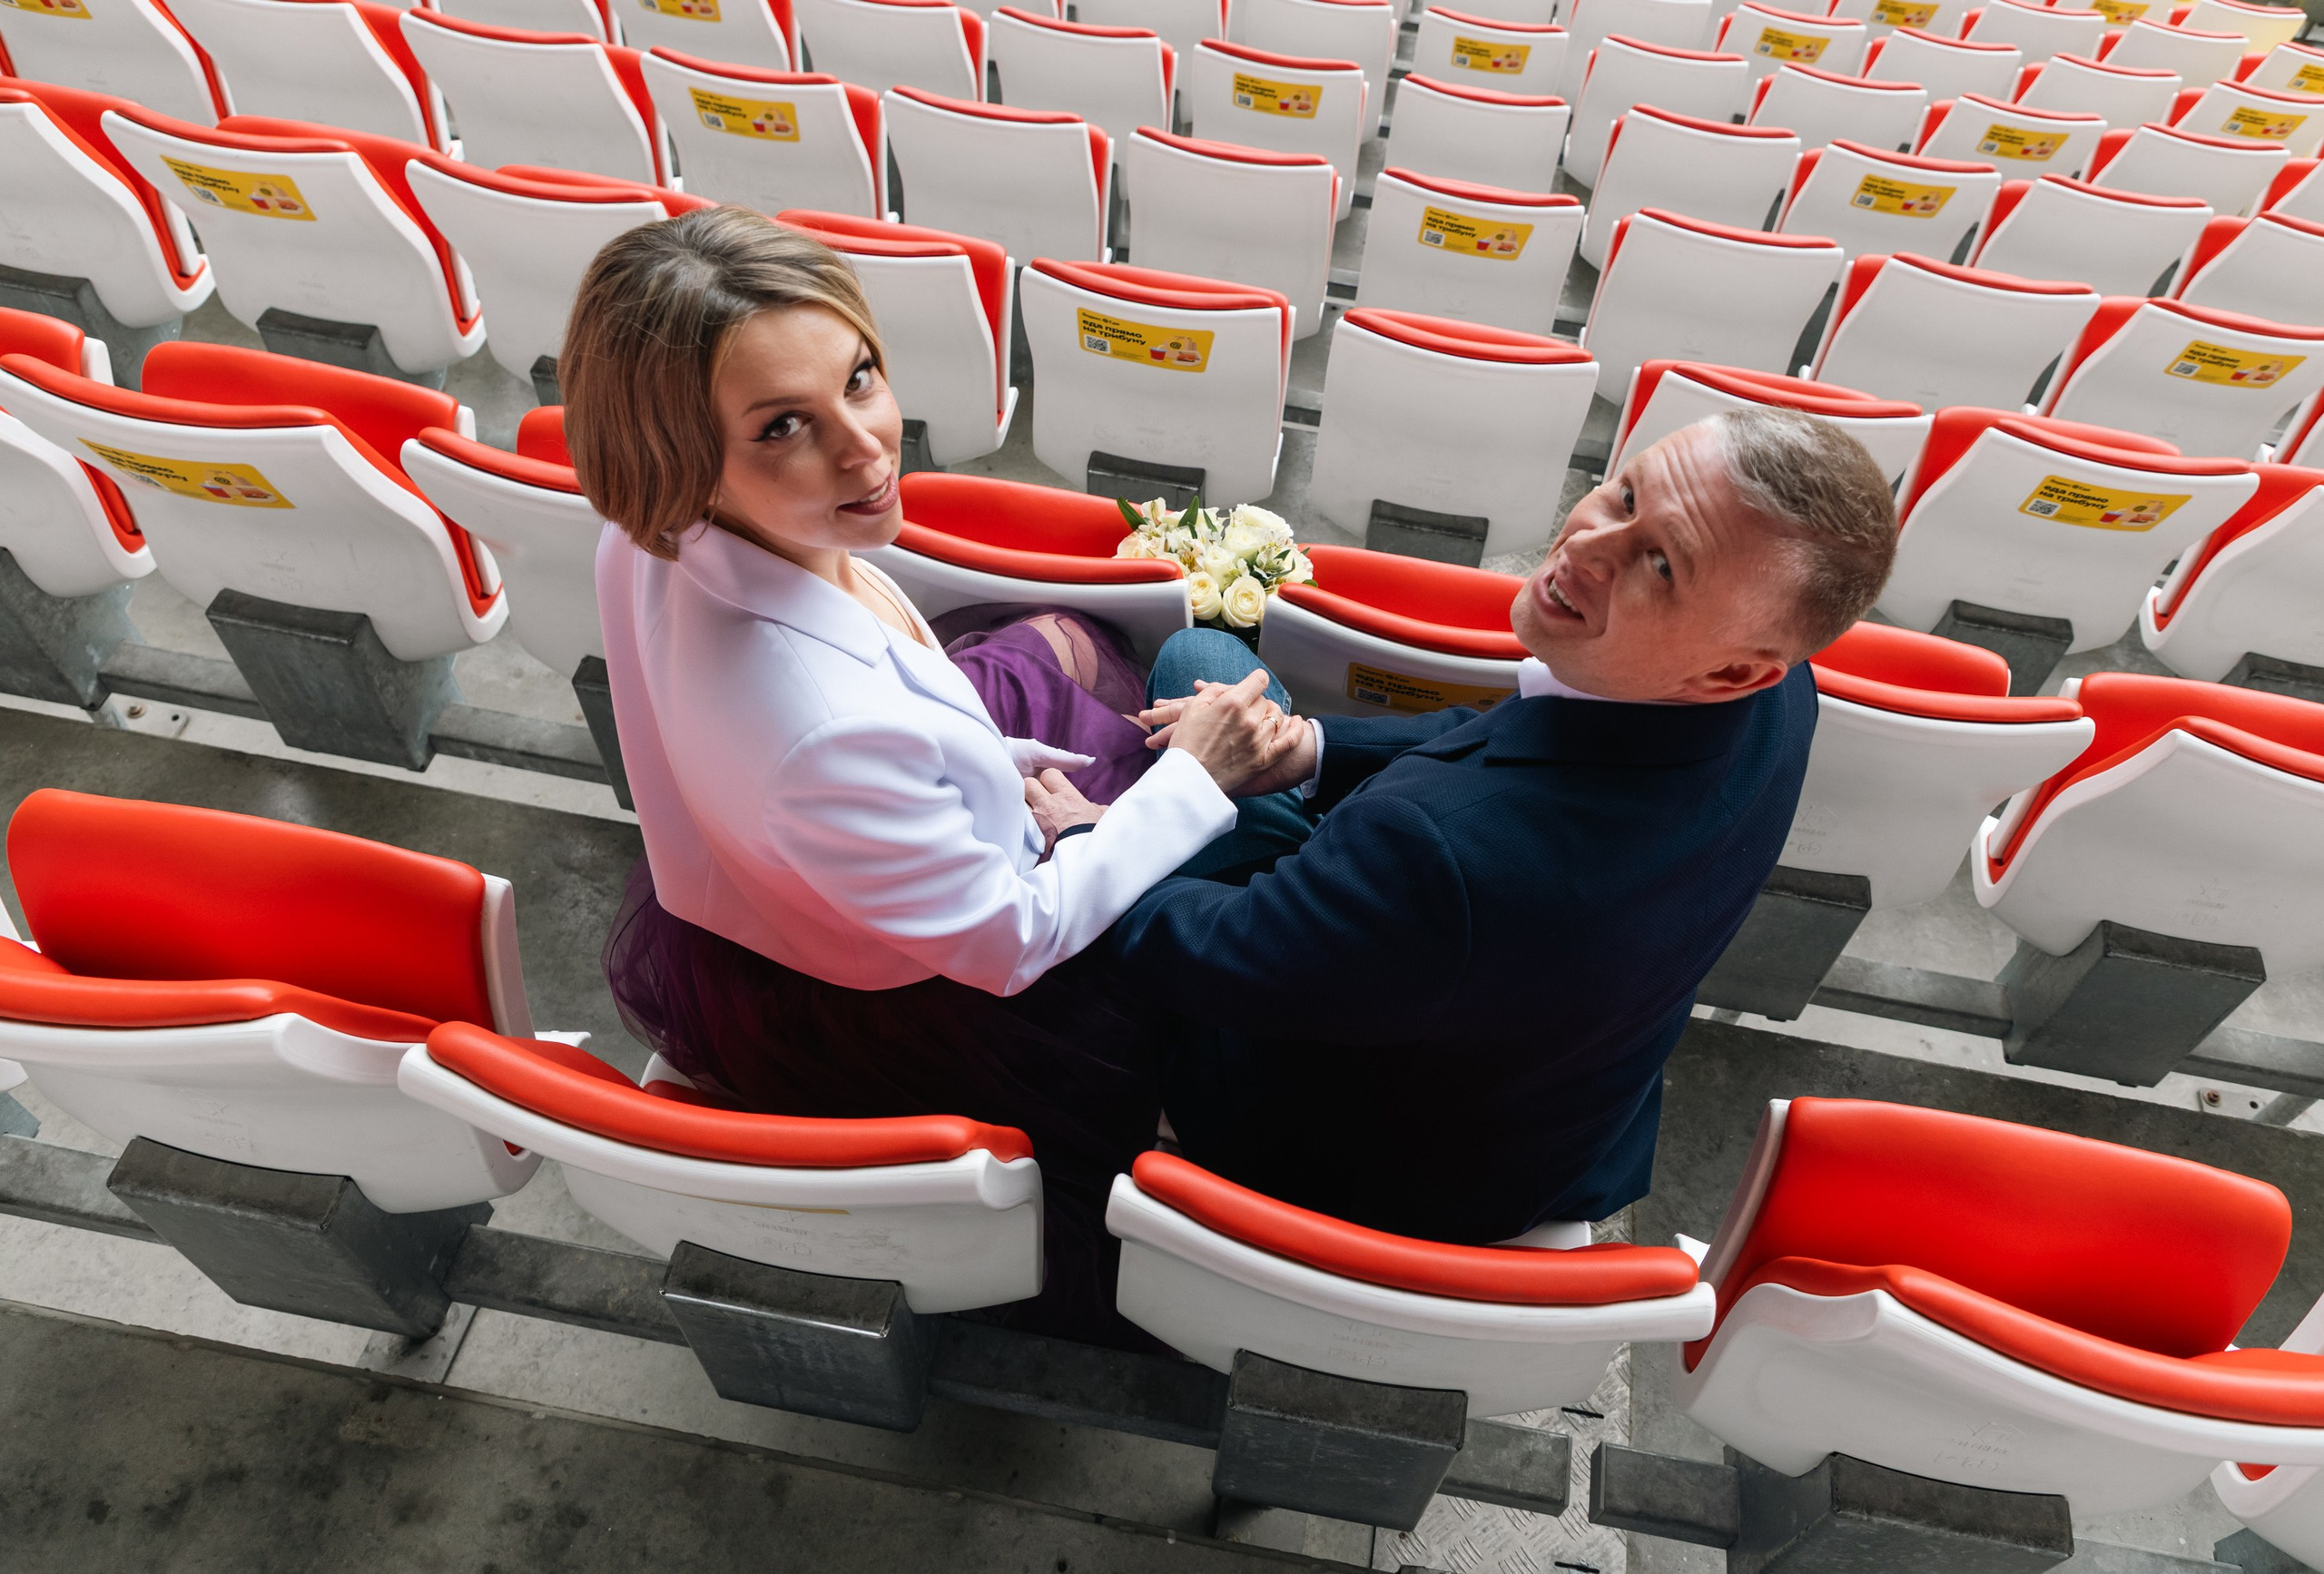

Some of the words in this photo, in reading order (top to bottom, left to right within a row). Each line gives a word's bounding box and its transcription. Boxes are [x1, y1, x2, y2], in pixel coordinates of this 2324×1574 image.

[1082, 320, 1103, 330] еда
[1105, 326, 1142, 339] прямо
[1083, 325, 1097, 333] на
[1098, 330, 1147, 345] трибуну
[2038, 490, 2054, 498] на
[2056, 495, 2108, 509] трибуну
[2043, 485, 2066, 495] еда
[2068, 491, 2109, 503] прямо
[1354, 678, 1374, 687] на
[1376, 684, 1444, 702] трибуну
[1355, 674, 1384, 685] еда
[1387, 681, 1440, 696] прямо
